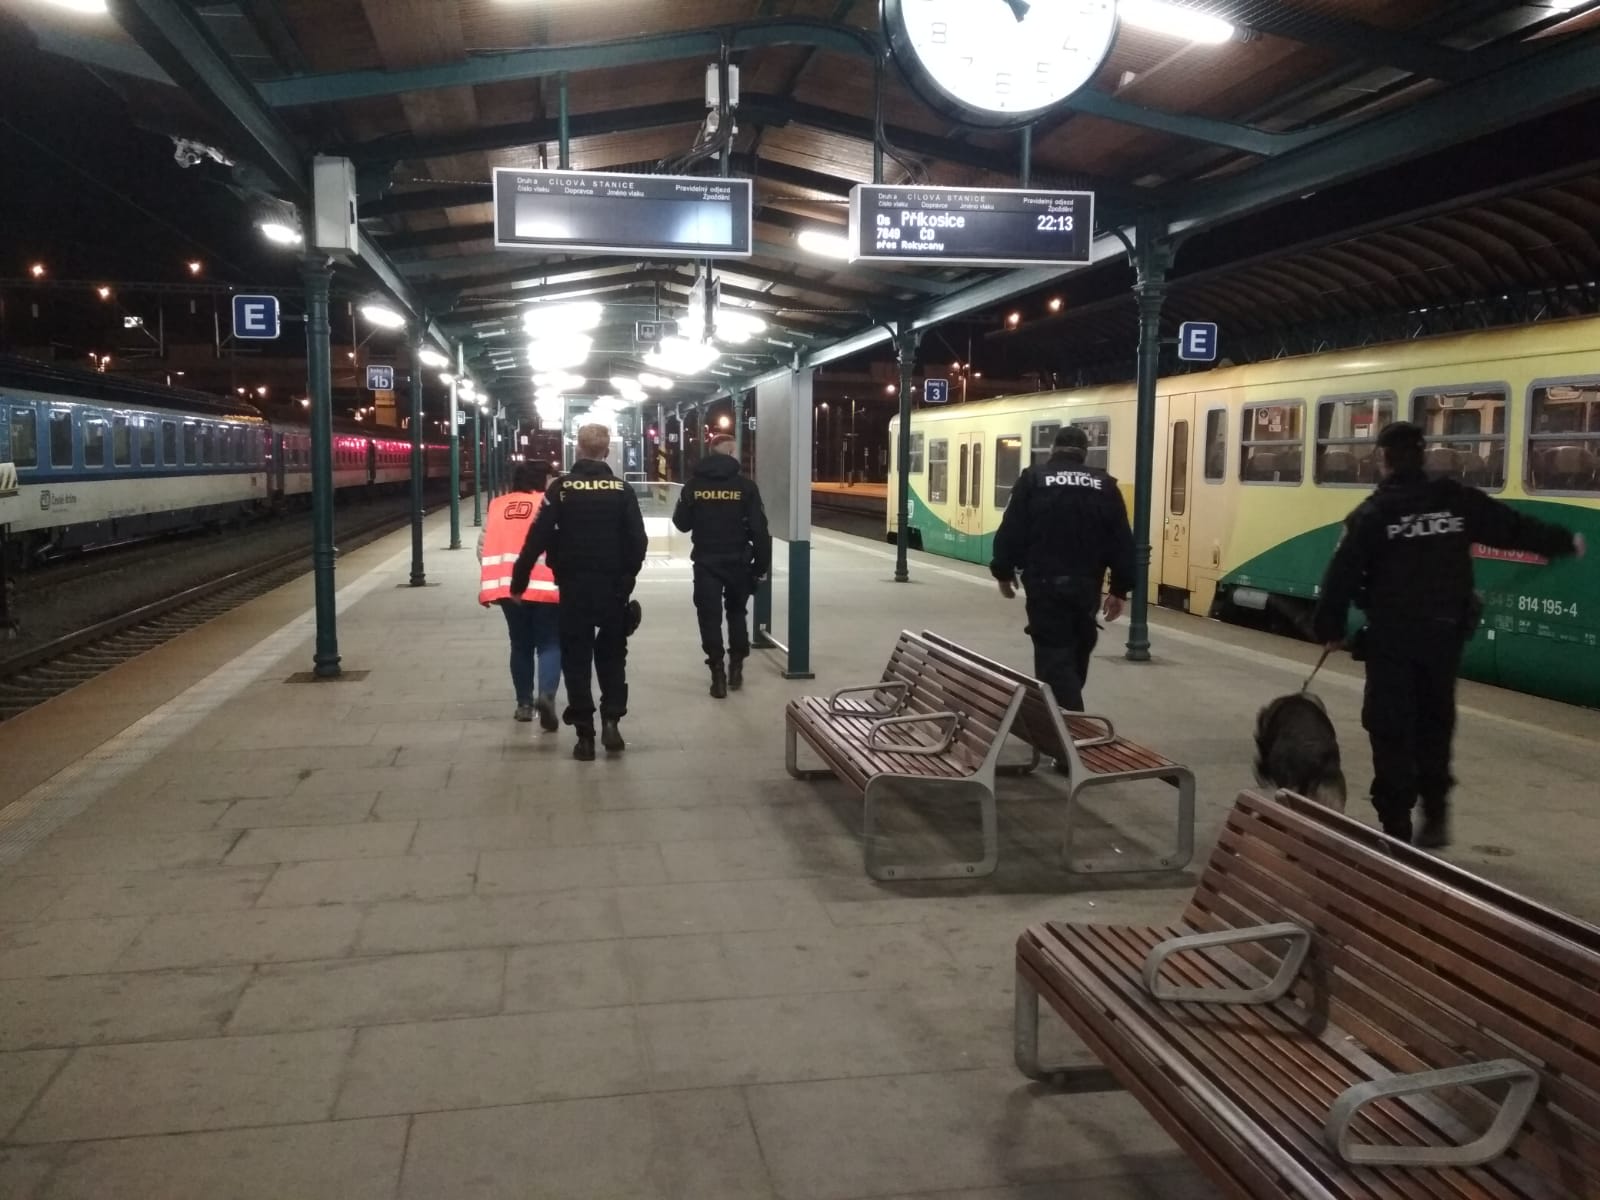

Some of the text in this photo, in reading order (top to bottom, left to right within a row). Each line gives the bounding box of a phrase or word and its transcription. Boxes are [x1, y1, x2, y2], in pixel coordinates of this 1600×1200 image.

[549, 178, 586, 187] CÍLOVÁ
[592, 180, 635, 189] STANICE
[565, 187, 594, 195] Dopravce
[947, 195, 986, 203] STANICE
[901, 210, 965, 228] Příkosice
[1037, 214, 1073, 231] 22:13
[919, 226, 935, 240] ČD
[876, 240, 944, 251] přes Rokycany
[244, 303, 266, 330] E
[1189, 329, 1207, 353] E
[372, 375, 389, 388] 1b
[933, 387, 941, 400] 3
[563, 479, 625, 491] POLICIE
[1045, 475, 1103, 490] POLICIE
[694, 490, 742, 501] POLICIE
[1174, 524, 1180, 542] 2
[1387, 517, 1465, 540] POLICIE
[1518, 595, 1538, 612] 814
[1542, 599, 1578, 617] 195-4
